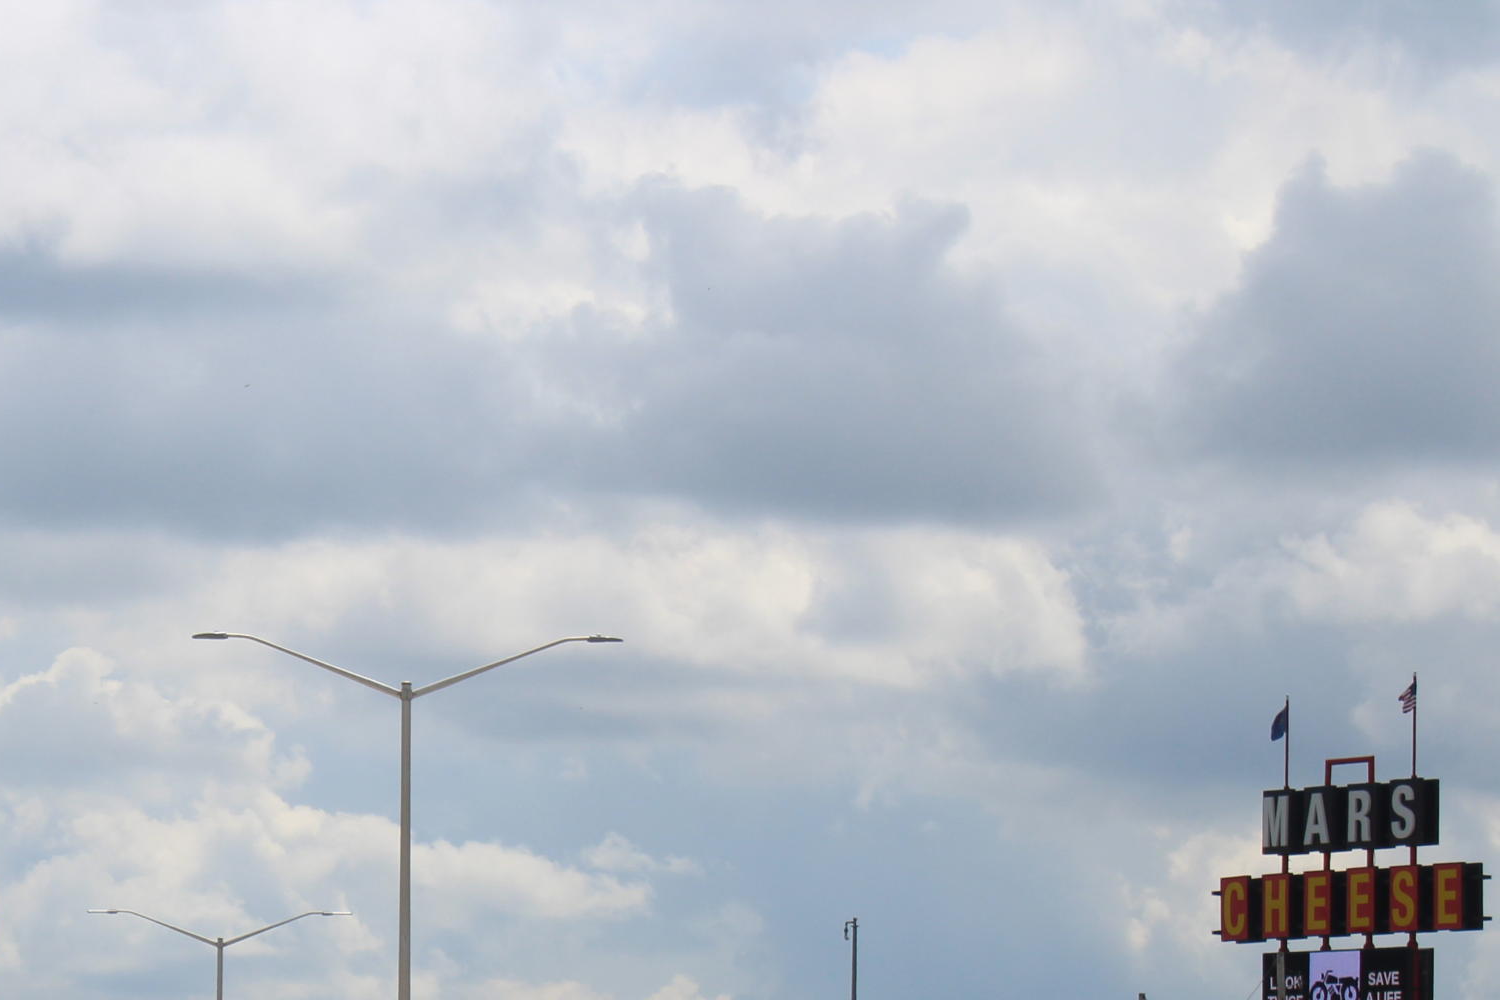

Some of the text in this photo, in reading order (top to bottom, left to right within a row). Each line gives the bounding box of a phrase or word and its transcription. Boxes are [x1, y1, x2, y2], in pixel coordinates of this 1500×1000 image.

[1262, 784, 1416, 848] MARS
[1223, 868, 1458, 936] CHEESE
[1270, 975, 1303, 991] LOK
[1368, 971, 1400, 986] SAVE
